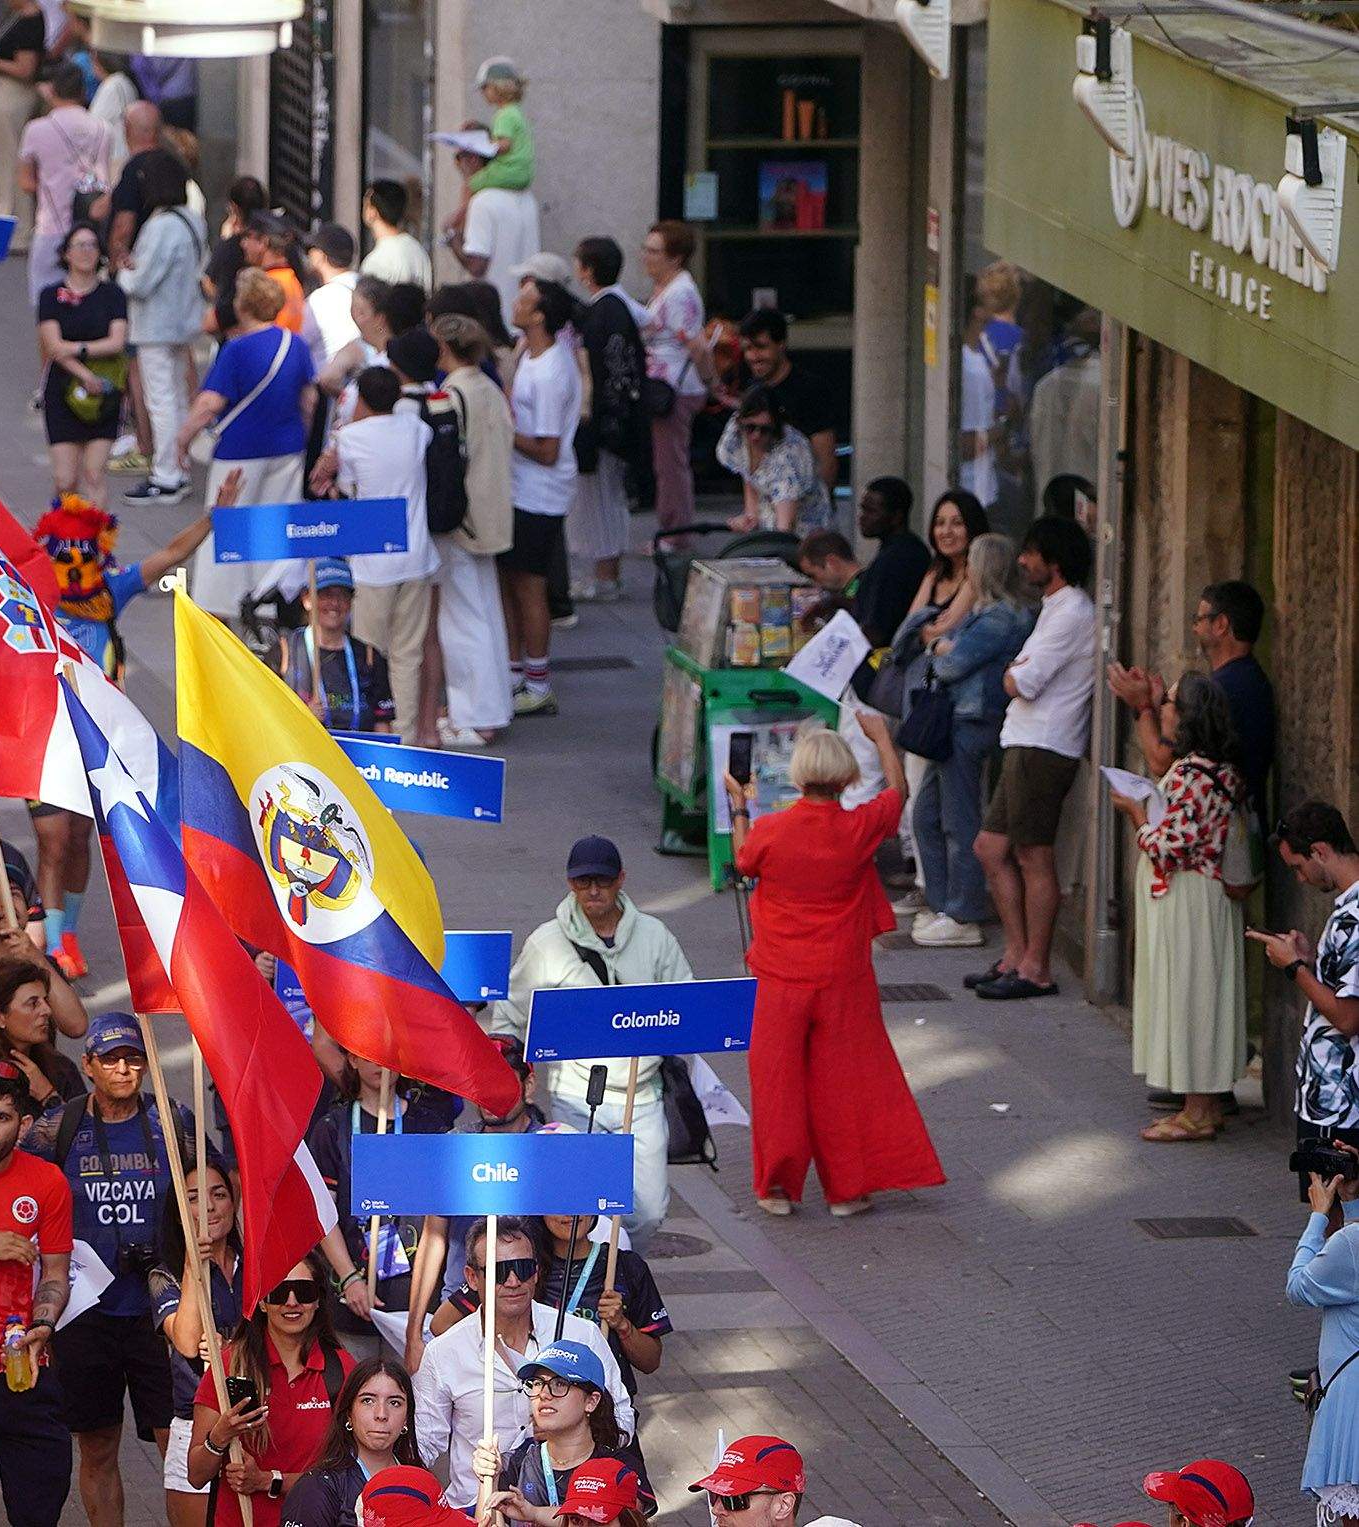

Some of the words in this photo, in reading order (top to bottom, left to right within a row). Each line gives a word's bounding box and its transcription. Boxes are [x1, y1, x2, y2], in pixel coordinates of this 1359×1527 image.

[1189, 249, 1273, 321] FRANCE
[285, 521, 341, 540] Ecuador
[355, 763, 381, 781] ech
[384, 766, 450, 790] Republic
[611, 1009, 680, 1029] Colombia
[471, 1162, 519, 1183] Chile
[84, 1179, 156, 1202] VIZCAYA
[97, 1203, 146, 1225] COL
